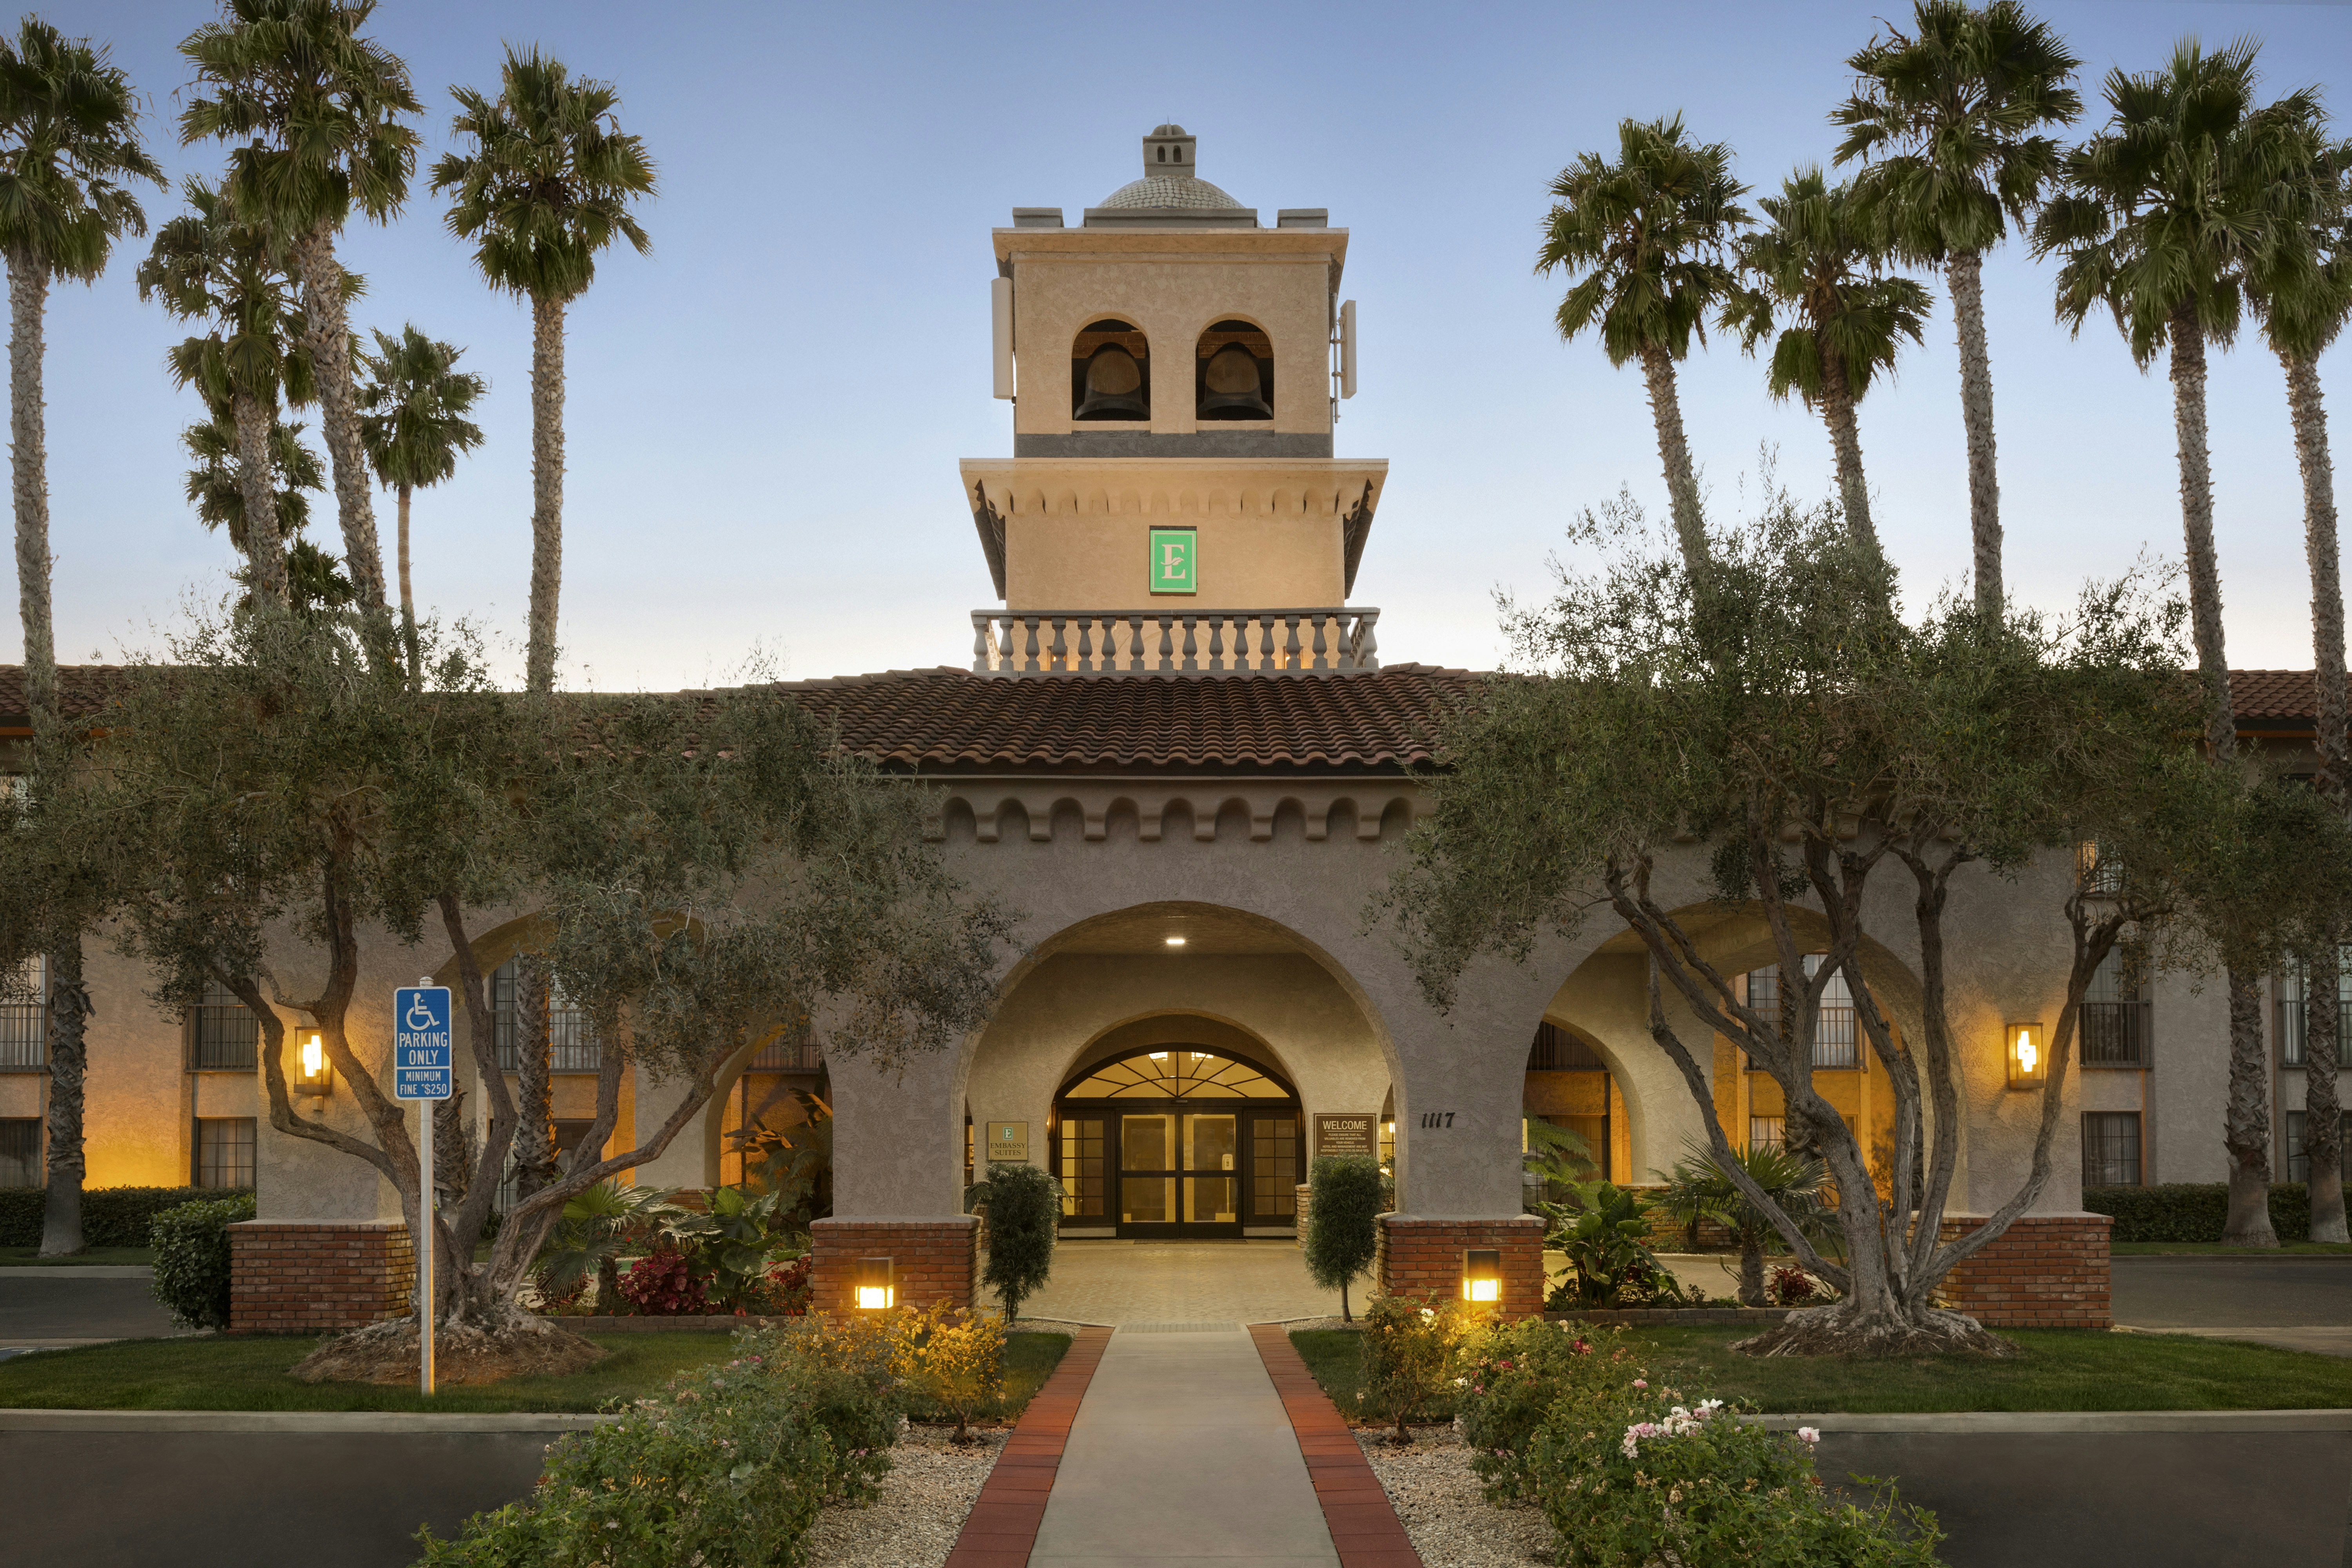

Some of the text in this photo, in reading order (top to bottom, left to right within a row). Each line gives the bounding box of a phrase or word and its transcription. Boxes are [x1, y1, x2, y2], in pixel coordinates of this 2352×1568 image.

[1160, 544, 1185, 579] E
[399, 1032, 447, 1047] PARKING
[408, 1050, 438, 1065] ONLY
[406, 1071, 441, 1081] MINIMUM
[400, 1083, 447, 1095] FINE $250
[1323, 1120, 1367, 1130] WELCOME
[1422, 1112, 1455, 1129] 1117
[1005, 1129, 1011, 1138] E
